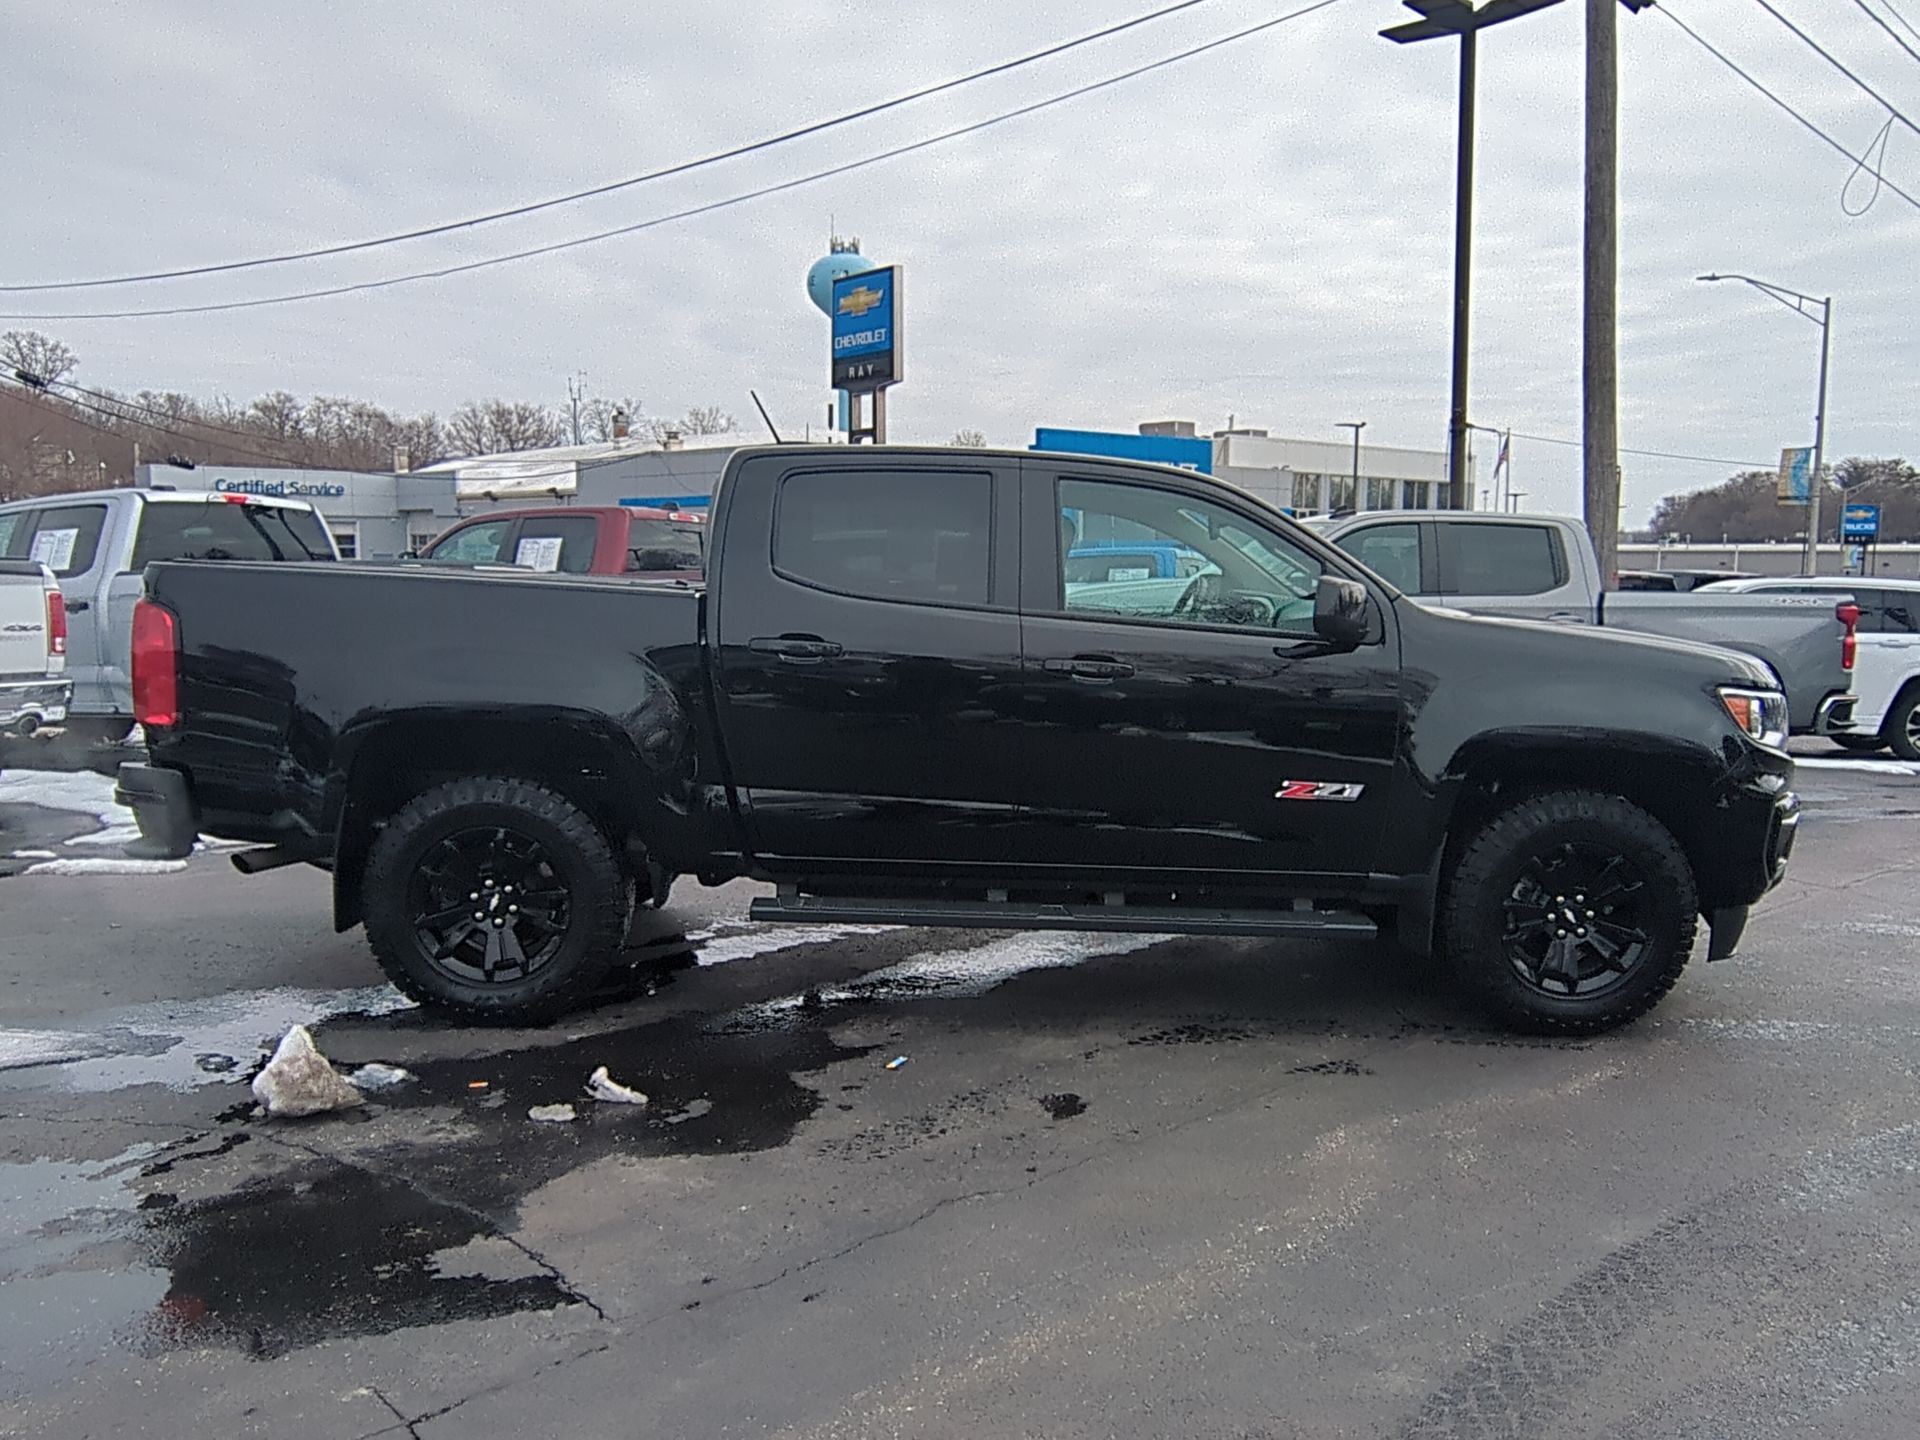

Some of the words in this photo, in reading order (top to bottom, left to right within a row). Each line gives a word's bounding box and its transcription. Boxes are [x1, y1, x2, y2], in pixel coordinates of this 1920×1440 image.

[834, 328, 887, 349] CHEVROLET
[848, 363, 874, 379] RAY
[215, 478, 284, 496] Certified
[289, 481, 345, 496] Service
[1275, 780, 1365, 801] Z71
